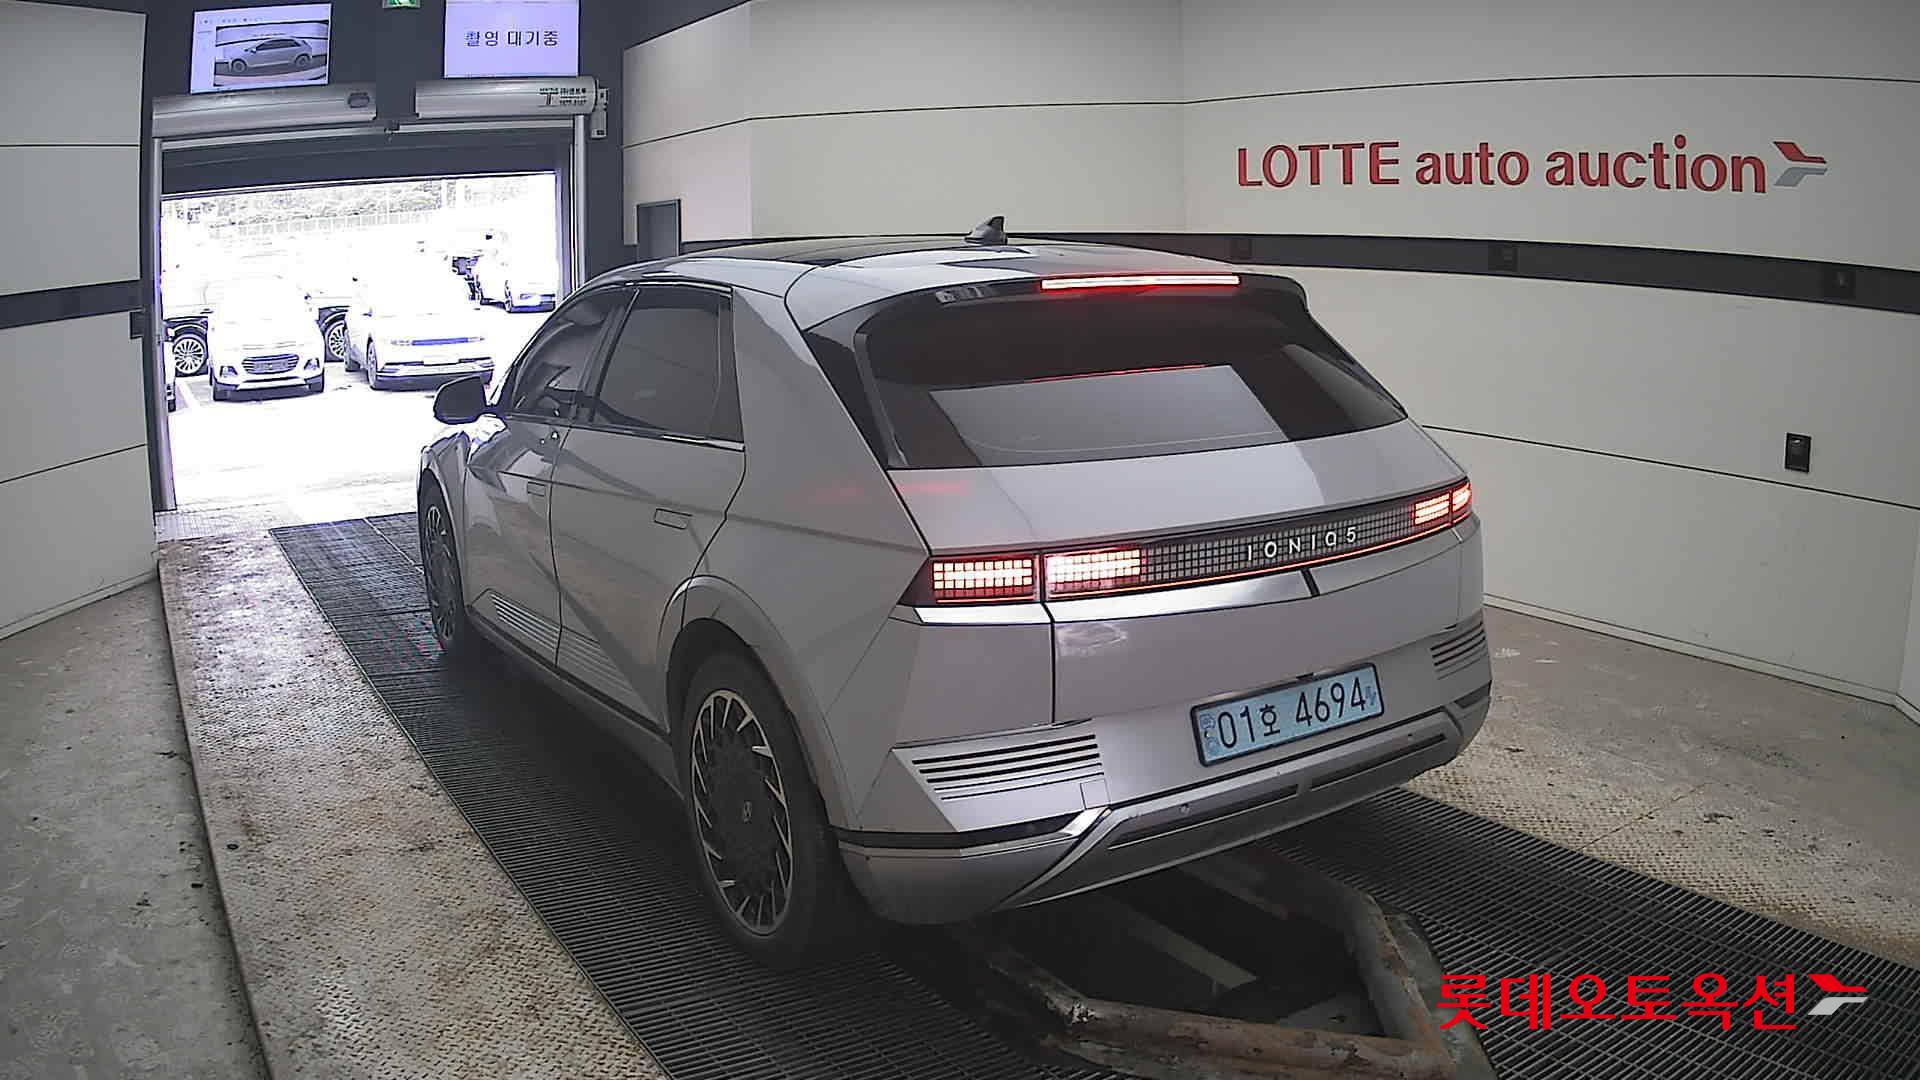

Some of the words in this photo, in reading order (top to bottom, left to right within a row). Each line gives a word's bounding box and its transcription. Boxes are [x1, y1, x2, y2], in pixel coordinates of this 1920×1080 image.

[507, 31, 558, 47] 대기중
[1237, 141, 1400, 187] LOTTE
[1415, 142, 1529, 186] auto
[1545, 134, 1767, 194] auction
[1247, 531, 1337, 561] IONIQ
[1346, 526, 1357, 543] 5
[1217, 703, 1281, 749] 01호
[1295, 676, 1367, 728] 4694
